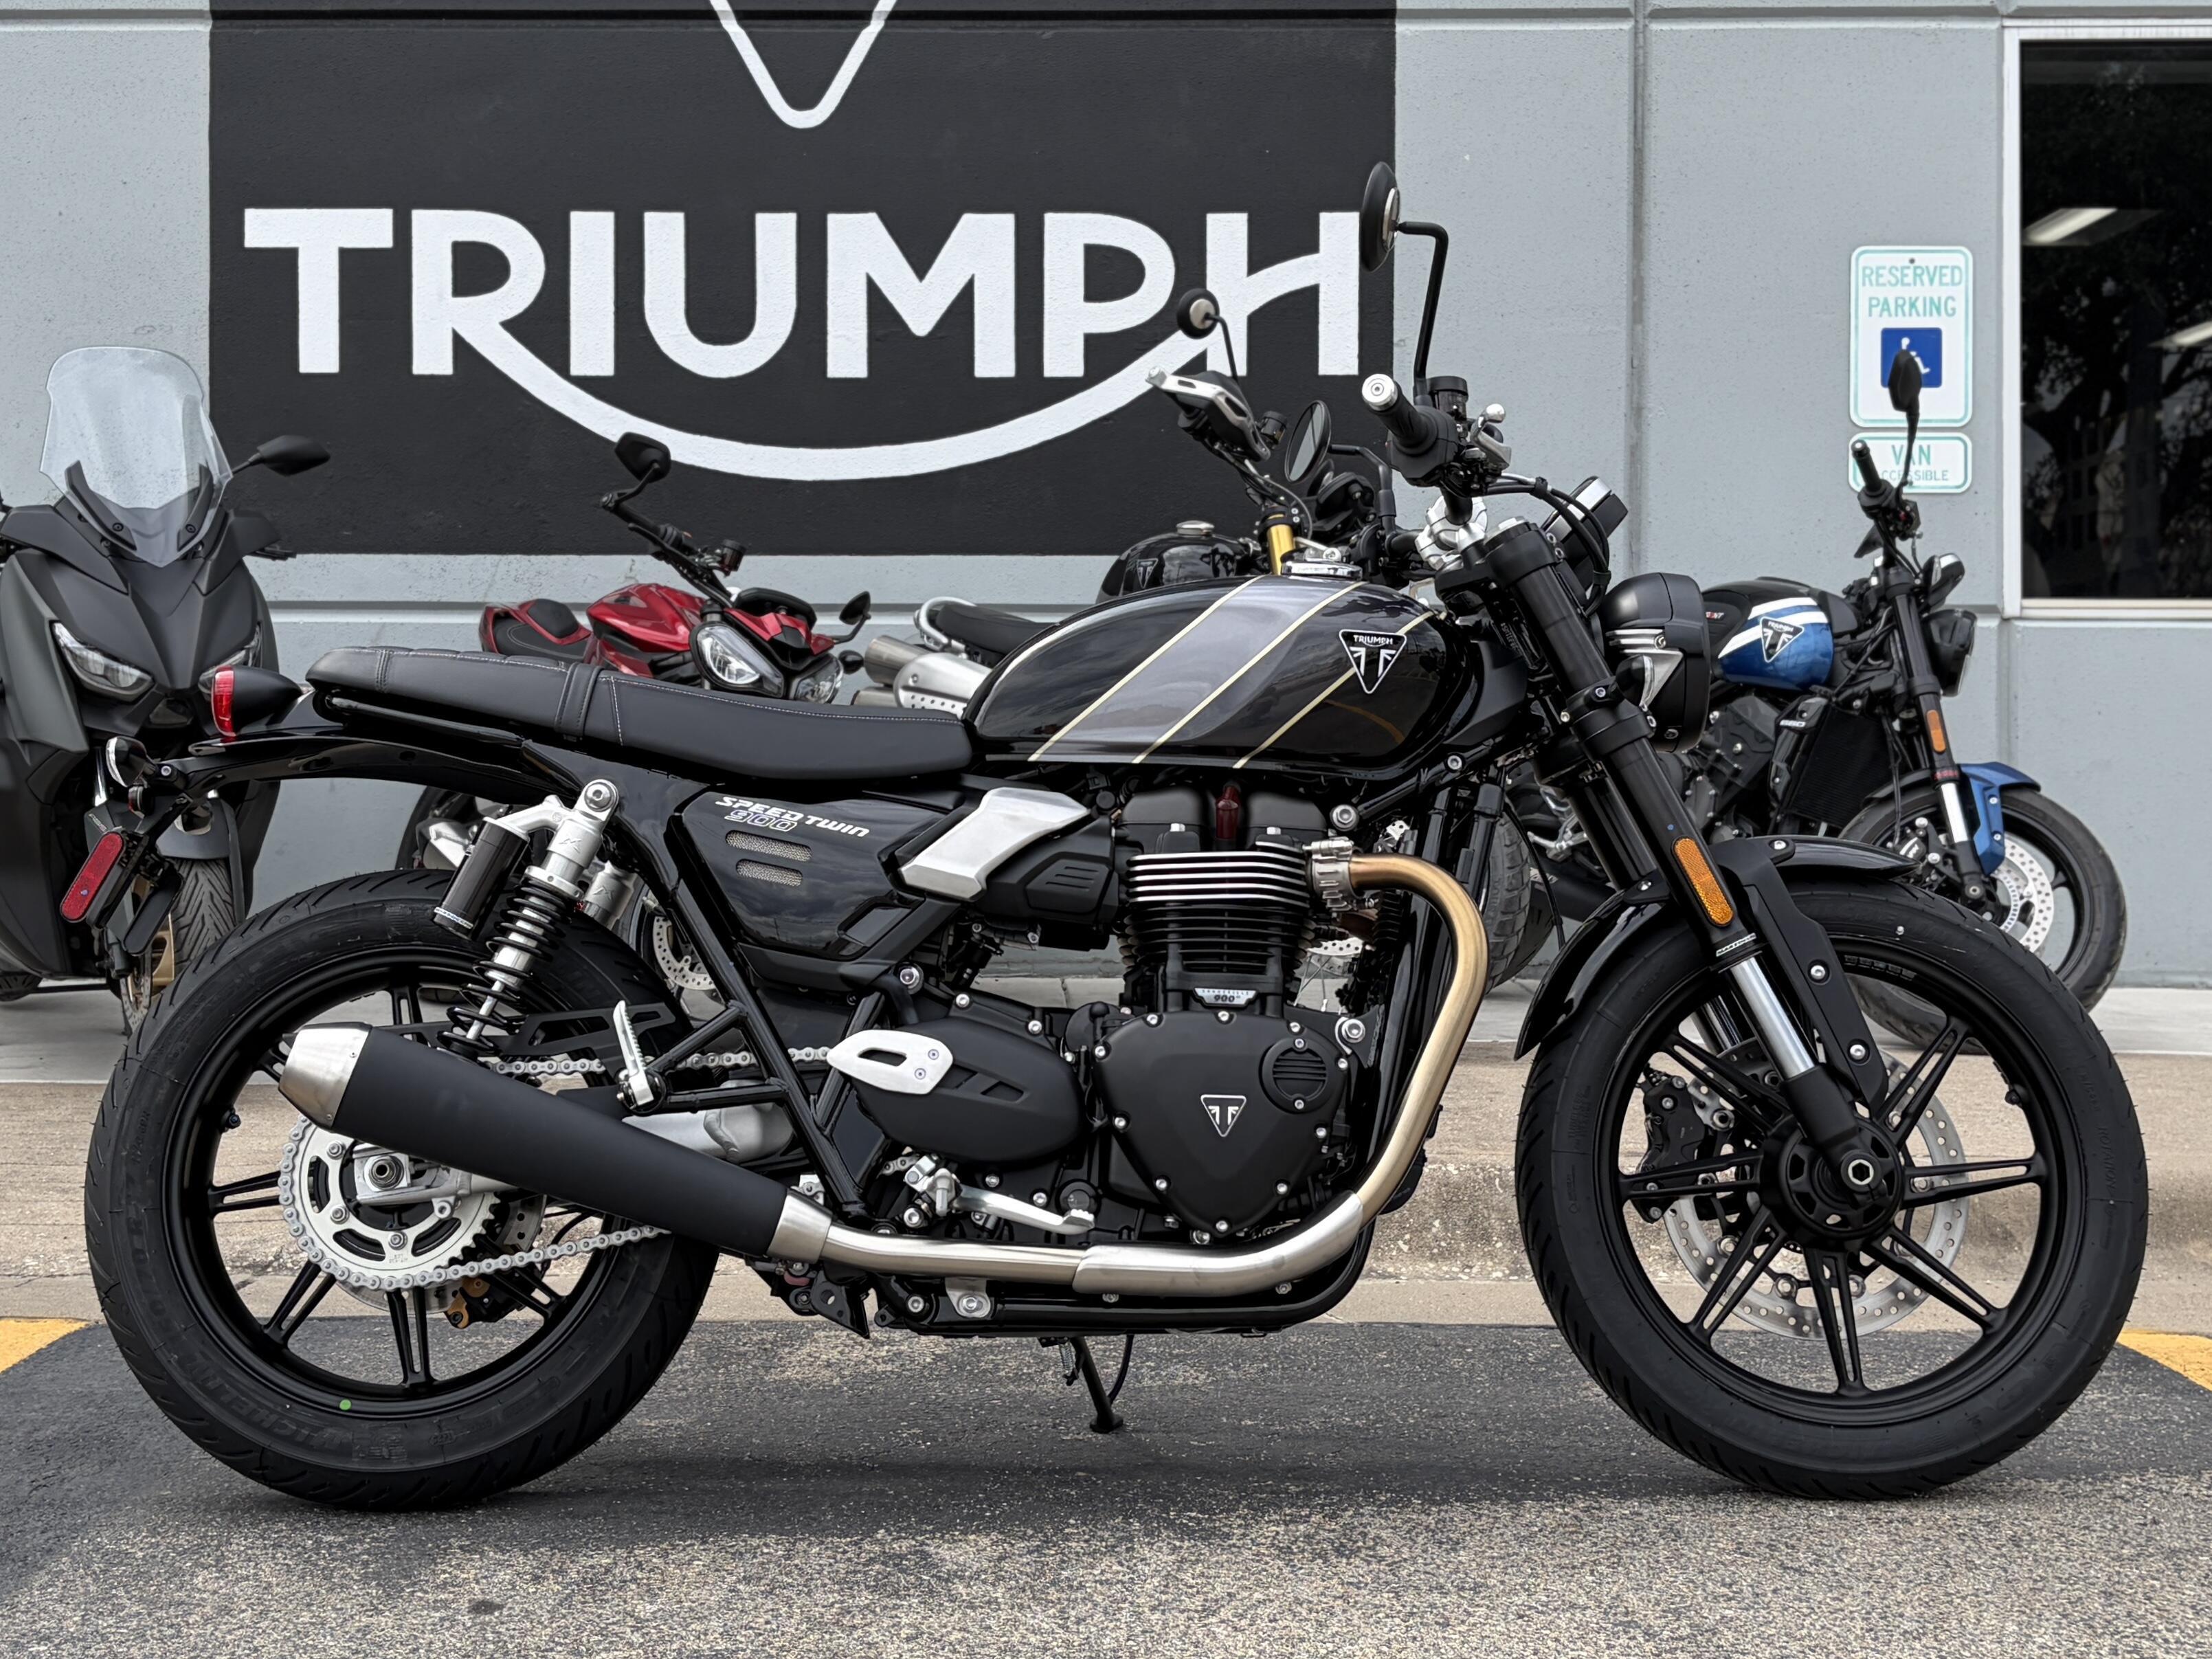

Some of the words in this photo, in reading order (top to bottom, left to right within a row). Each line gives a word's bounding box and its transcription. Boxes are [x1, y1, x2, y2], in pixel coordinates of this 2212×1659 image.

[1862, 265, 1963, 287] RESERVED
[1868, 296, 1957, 318] PARKING
[244, 208, 1360, 480] TRIUMPH
[1891, 445, 1931, 465] VN
[1353, 634, 1394, 647] TRIUMPH
[715, 797, 804, 821] SPEED
[805, 815, 870, 837] TWIN
[724, 810, 798, 832] 900
[1214, 994, 1236, 1003] 900
